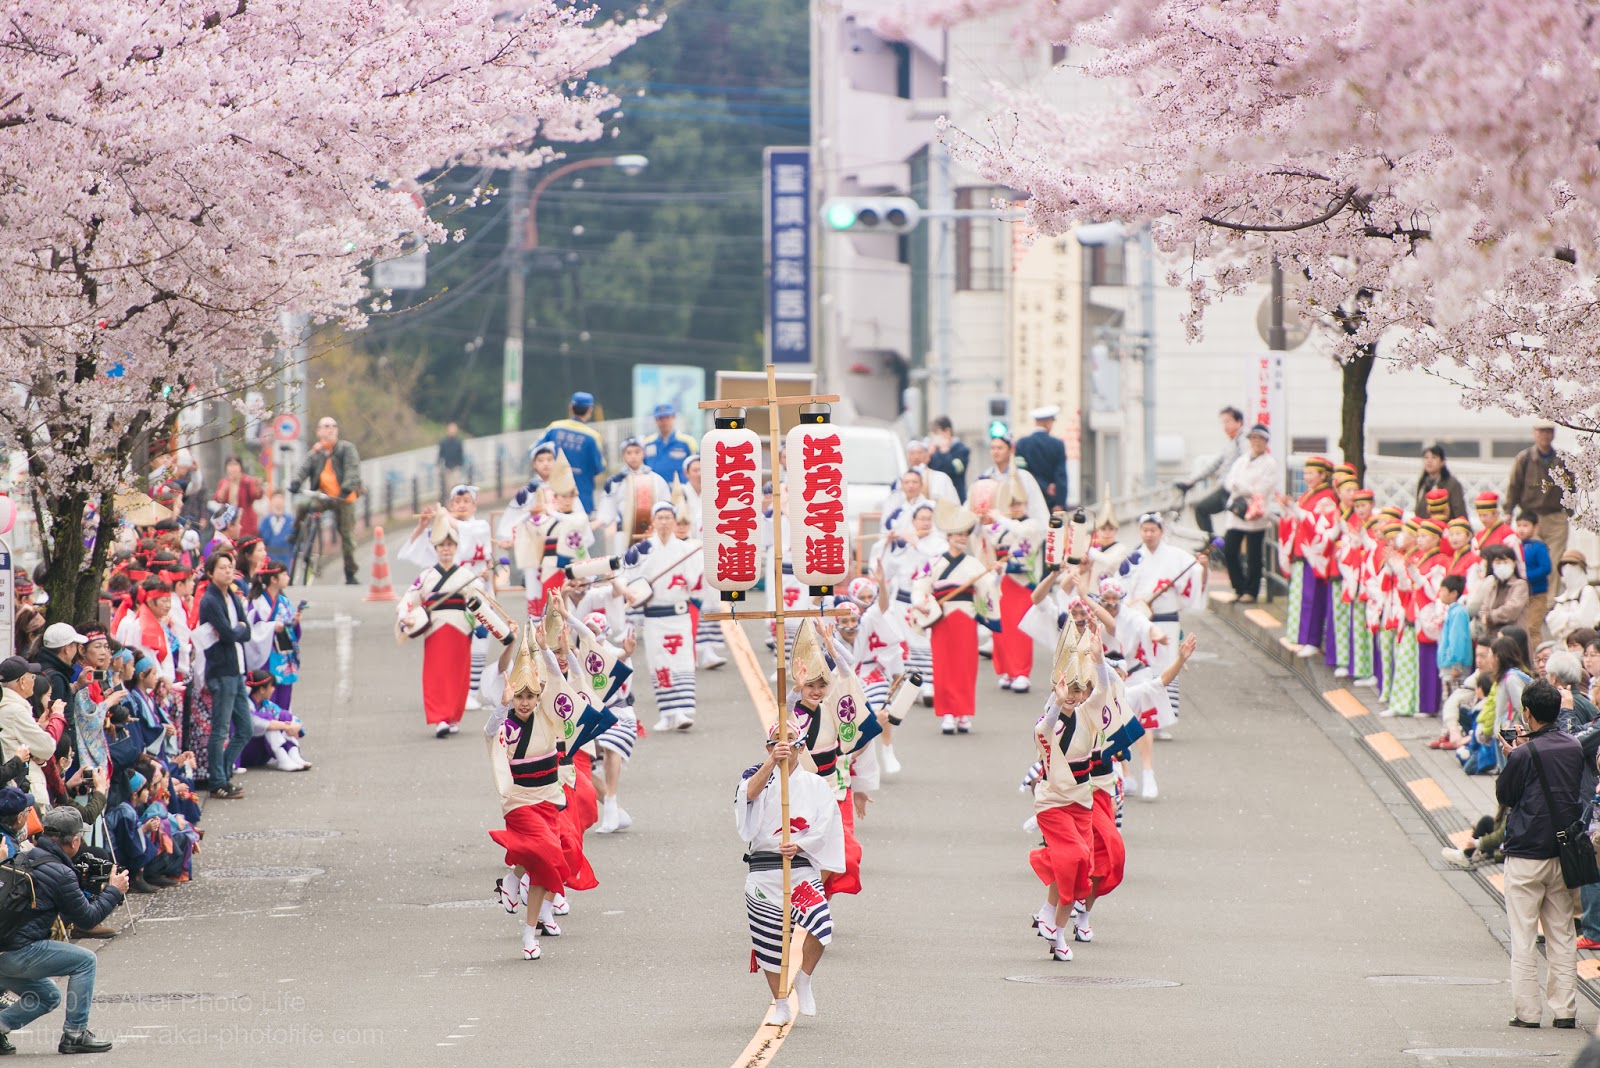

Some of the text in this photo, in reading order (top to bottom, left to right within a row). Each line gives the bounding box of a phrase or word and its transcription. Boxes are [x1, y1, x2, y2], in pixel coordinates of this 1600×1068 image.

[714, 440, 758, 582] 江戸っ子連
[802, 433, 845, 575] 江戸っ子連
